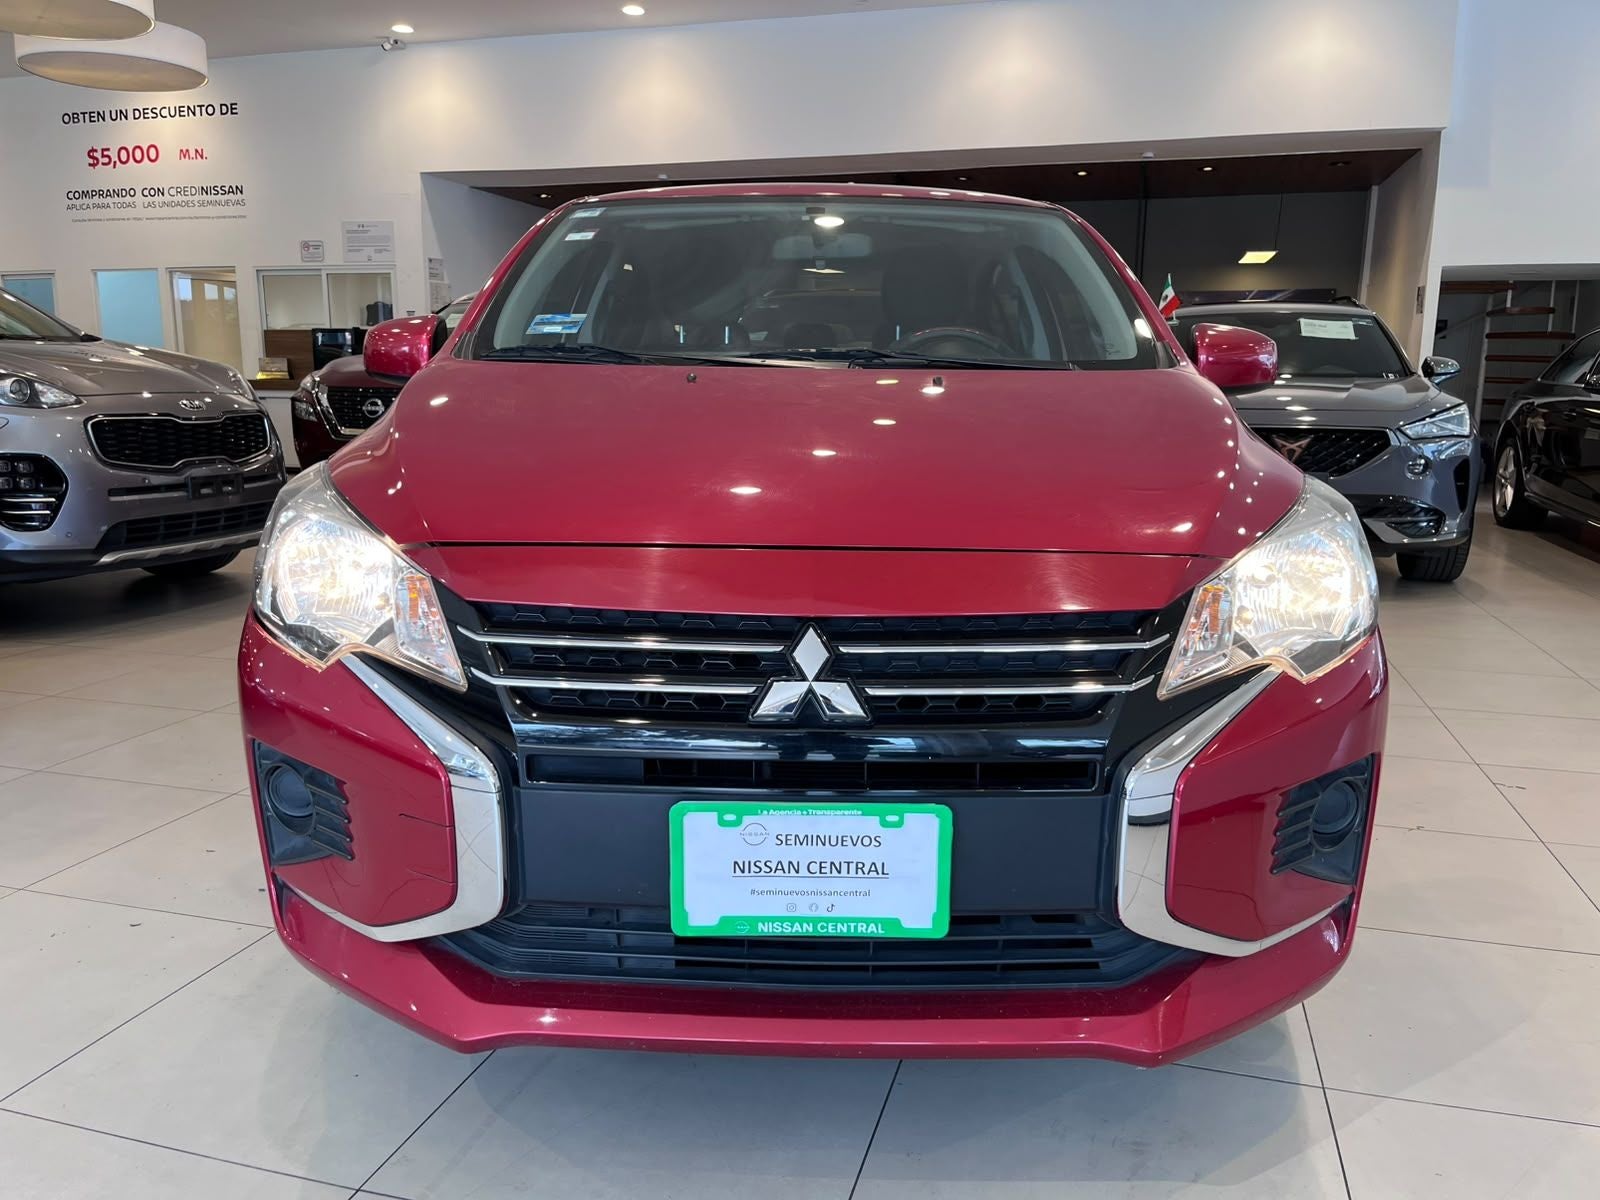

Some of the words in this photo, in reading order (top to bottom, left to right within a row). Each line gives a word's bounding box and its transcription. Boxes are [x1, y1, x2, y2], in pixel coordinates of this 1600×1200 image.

[62, 110, 105, 125] OBTEN
[109, 109, 128, 122] UN
[133, 104, 216, 120] DESCUENTO
[219, 102, 238, 116] DE
[87, 144, 159, 169] $5,000
[178, 148, 208, 161] M.N.
[66, 187, 137, 201] COMPRANDO
[141, 187, 165, 198] CON
[168, 184, 244, 197] CREDINISSAN
[66, 203, 91, 211] APLICA
[92, 202, 111, 210] PARA
[112, 201, 137, 209] TODAS
[142, 201, 156, 209] LAS
[158, 200, 196, 208] UNIDADES
[197, 199, 246, 208] SEMINUEVAS
[775, 833, 882, 848] SEMINUEVOS
[732, 860, 801, 875] NISSAN
[806, 861, 889, 876] CENTRAL
[750, 888, 871, 898] #seminuevosnissancentral
[757, 922, 814, 934] NISSAN
[817, 922, 885, 935] CENTRAL
